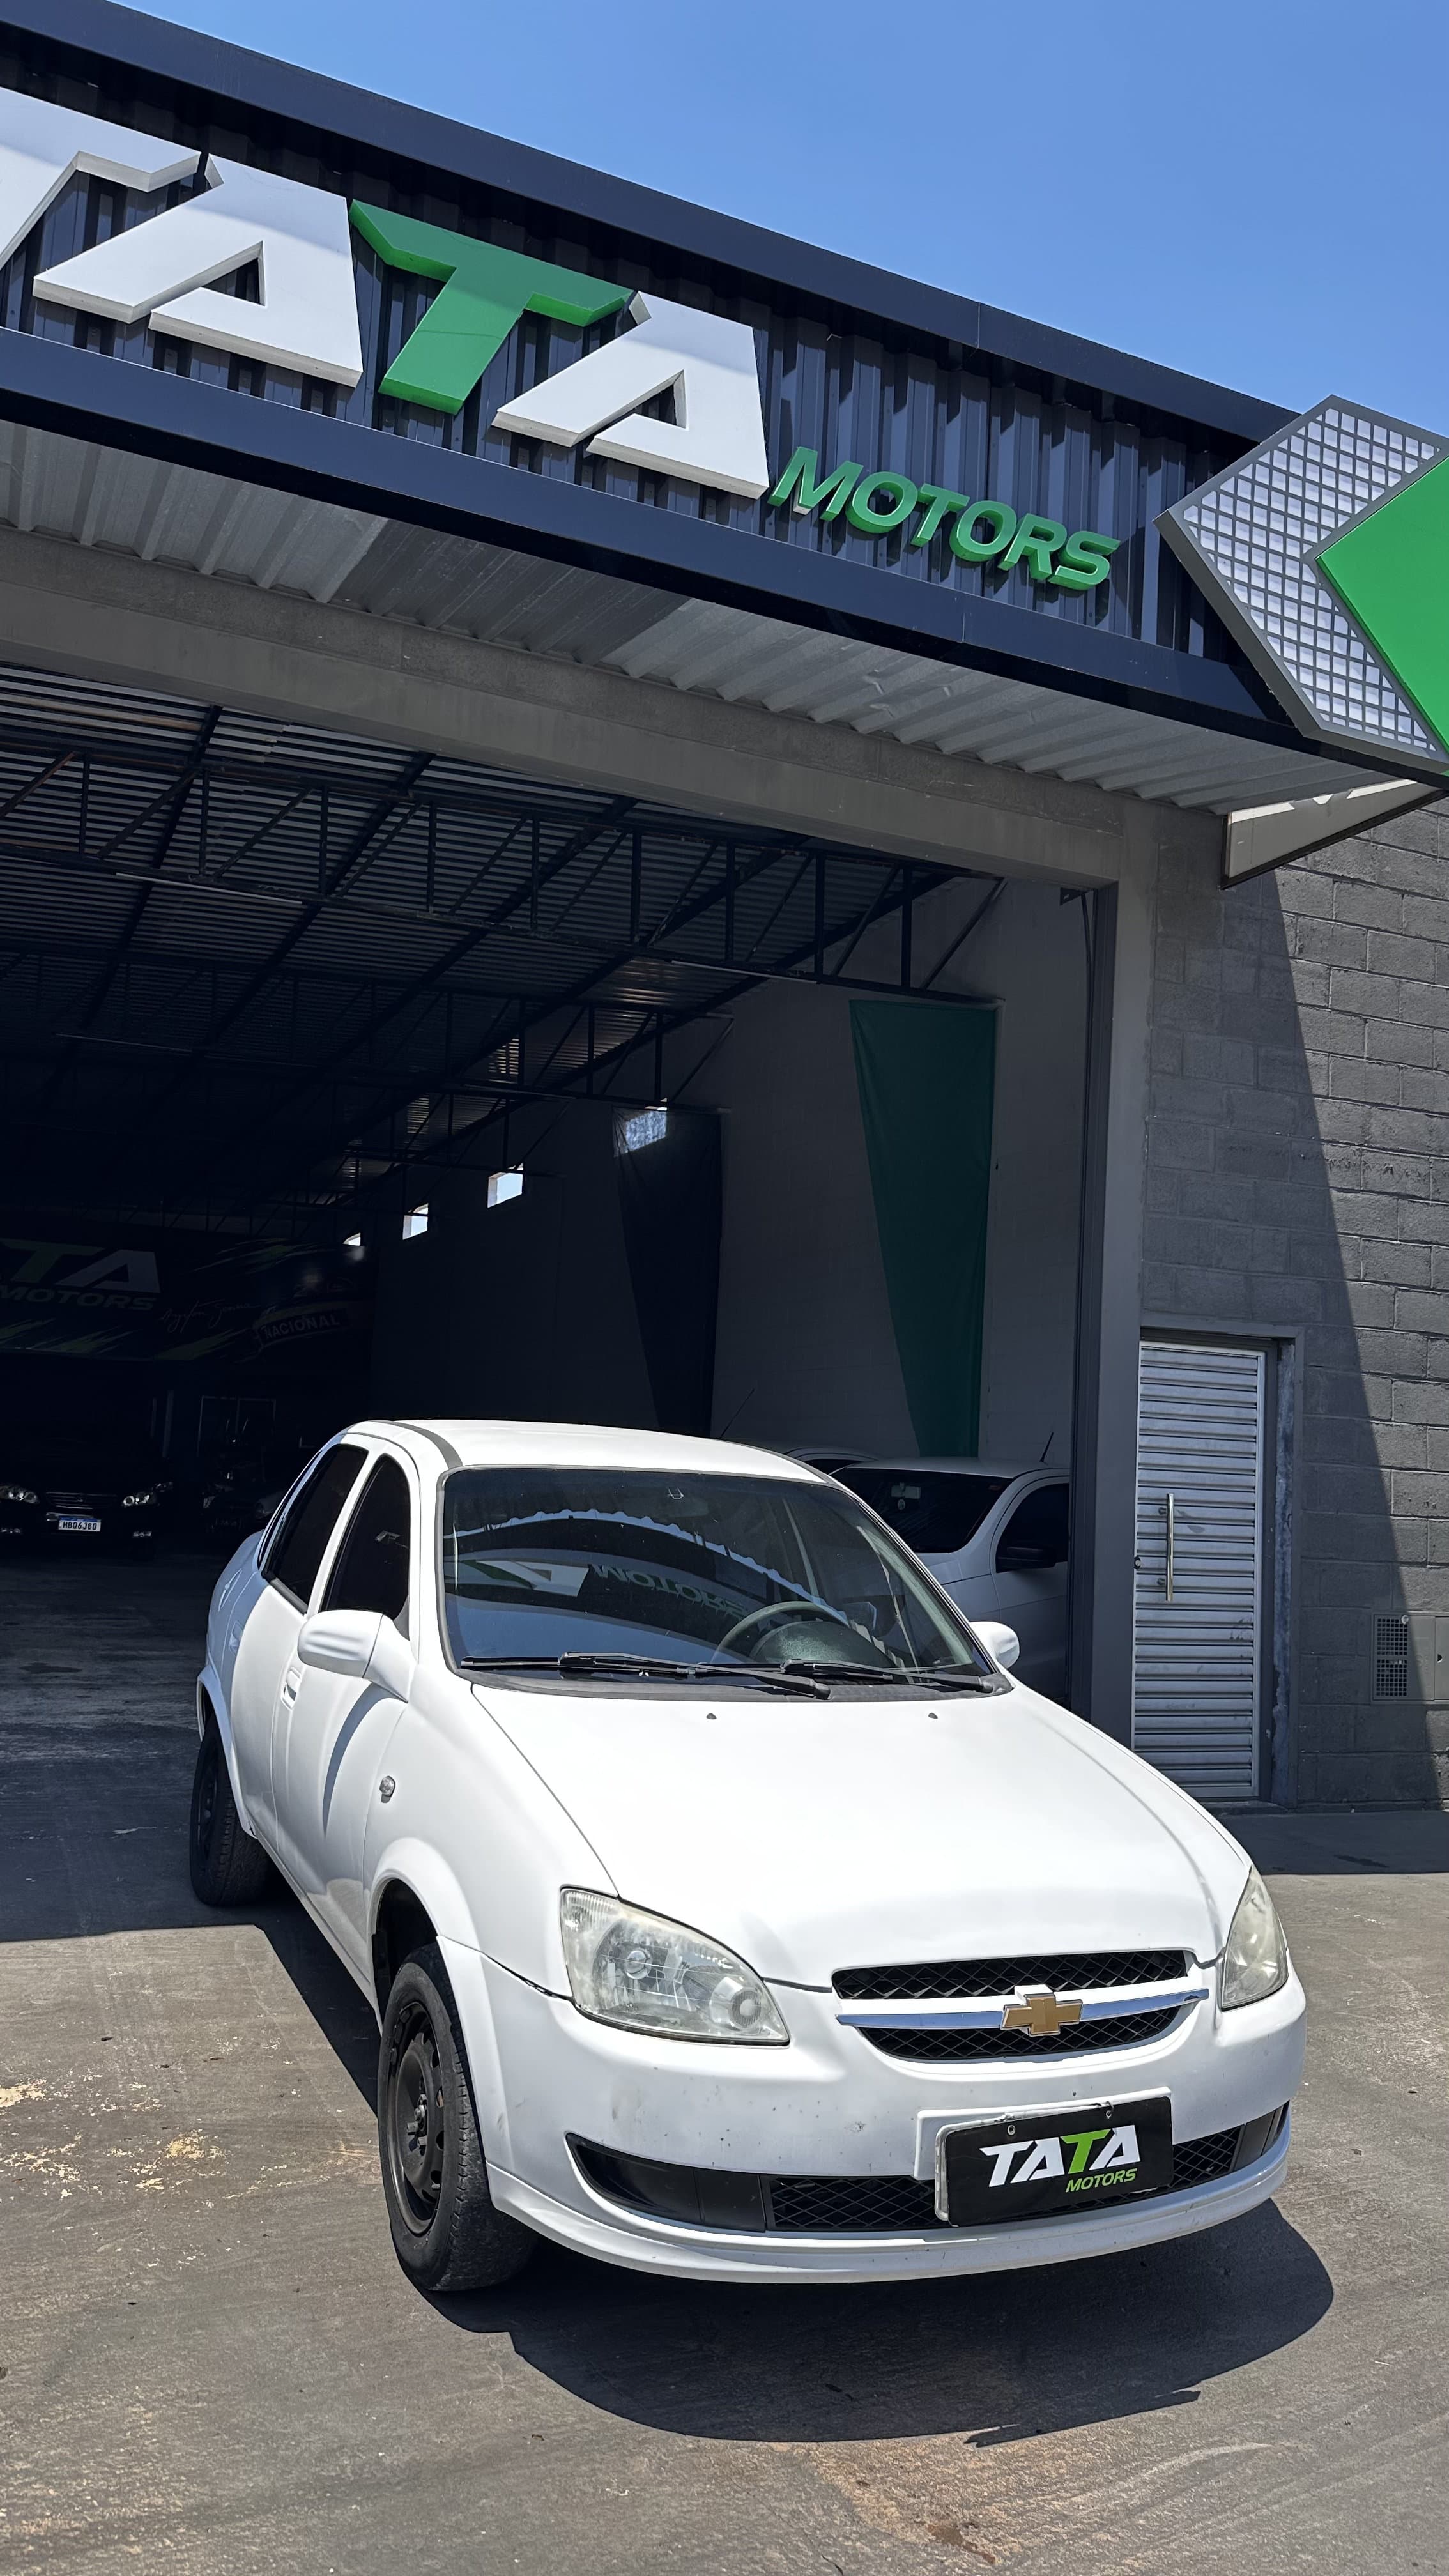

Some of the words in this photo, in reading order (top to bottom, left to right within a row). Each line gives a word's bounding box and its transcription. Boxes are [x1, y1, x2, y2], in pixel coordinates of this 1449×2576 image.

[768, 446, 1121, 591] MOTORS
[0, 1284, 157, 1311] MOTORS
[263, 1313, 341, 1339] NACIONAL
[979, 2124, 1141, 2188] TATA
[1066, 2168, 1138, 2193] MOTORS
